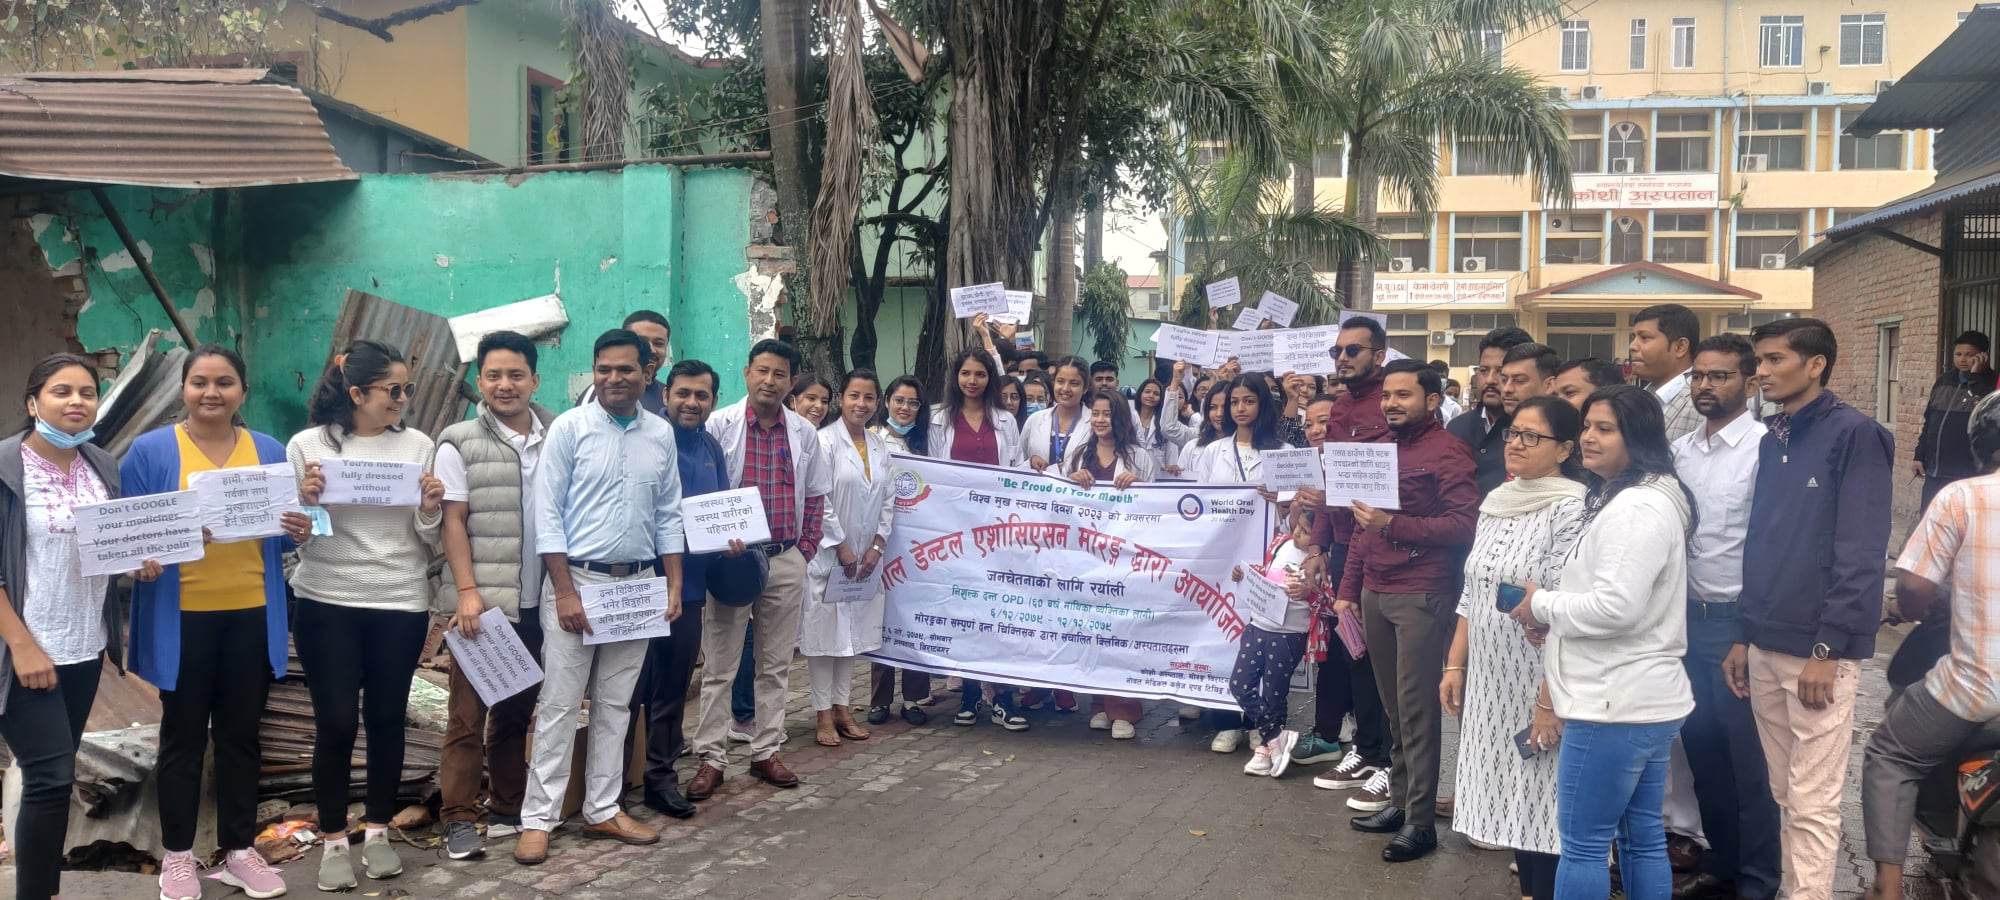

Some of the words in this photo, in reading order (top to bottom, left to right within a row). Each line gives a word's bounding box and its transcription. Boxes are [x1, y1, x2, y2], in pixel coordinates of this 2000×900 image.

[1574, 189, 1618, 201] कोशी
[1629, 190, 1715, 201] अस्पताल
[343, 459, 374, 467] You're
[376, 461, 404, 469] never
[340, 471, 362, 480] fully
[365, 472, 404, 480] dressed
[250, 486, 269, 496] साथ
[353, 483, 392, 492] without
[1021, 480, 1051, 494] Proud
[1054, 485, 1069, 494] of
[1070, 488, 1096, 499] Your
[99, 503, 130, 516] Don't
[132, 497, 179, 512] GOOGLE
[360, 496, 392, 505] SMILE
[725, 494, 743, 507] मुख
[968, 490, 991, 505] विश्व
[994, 495, 1012, 509] मुख
[1015, 498, 1048, 512] स्वास्थ्य
[1077, 507, 1103, 521] २०२३
[1107, 510, 1121, 521] को
[1236, 498, 1255, 506] Oral
[722, 504, 754, 519] शरीरको
[1211, 507, 1238, 515] Health
[1239, 507, 1256, 516] Day
[97, 520, 124, 533] your
[705, 522, 738, 536] पहिचान
[738, 518, 749, 531] हो
[92, 536, 120, 548] Your
[122, 530, 164, 544] doctors
[165, 526, 191, 537] have
[97, 550, 128, 561] taken
[130, 545, 144, 557] all
[146, 543, 164, 554] the
[166, 540, 191, 553] pain
[910, 531, 965, 572] डेन्टल
[971, 512, 1071, 559] एशोसिएसन
[1130, 543, 1173, 583] द्वारा
[1174, 568, 1247, 643] आयोजित
[986, 569, 1051, 589] जनचेतनाको
[1057, 576, 1084, 592] लागि
[602, 598, 620, 610] भनेर
[983, 590, 998, 602] दन्त
[1001, 594, 1024, 606] OPD
[598, 612, 614, 625] अनि
[616, 611, 631, 622] मात्र
[633, 607, 658, 618] उपचार
[978, 621, 994, 633] दन्त
[1039, 630, 1058, 642] द्वारा
[494, 624, 511, 645] Don't
[508, 644, 530, 673] GOOGLE
[470, 657, 480, 668] all
[476, 666, 488, 679] the
[484, 677, 499, 694] pain
[479, 648, 499, 675] doctors
[496, 672, 511, 690] have
